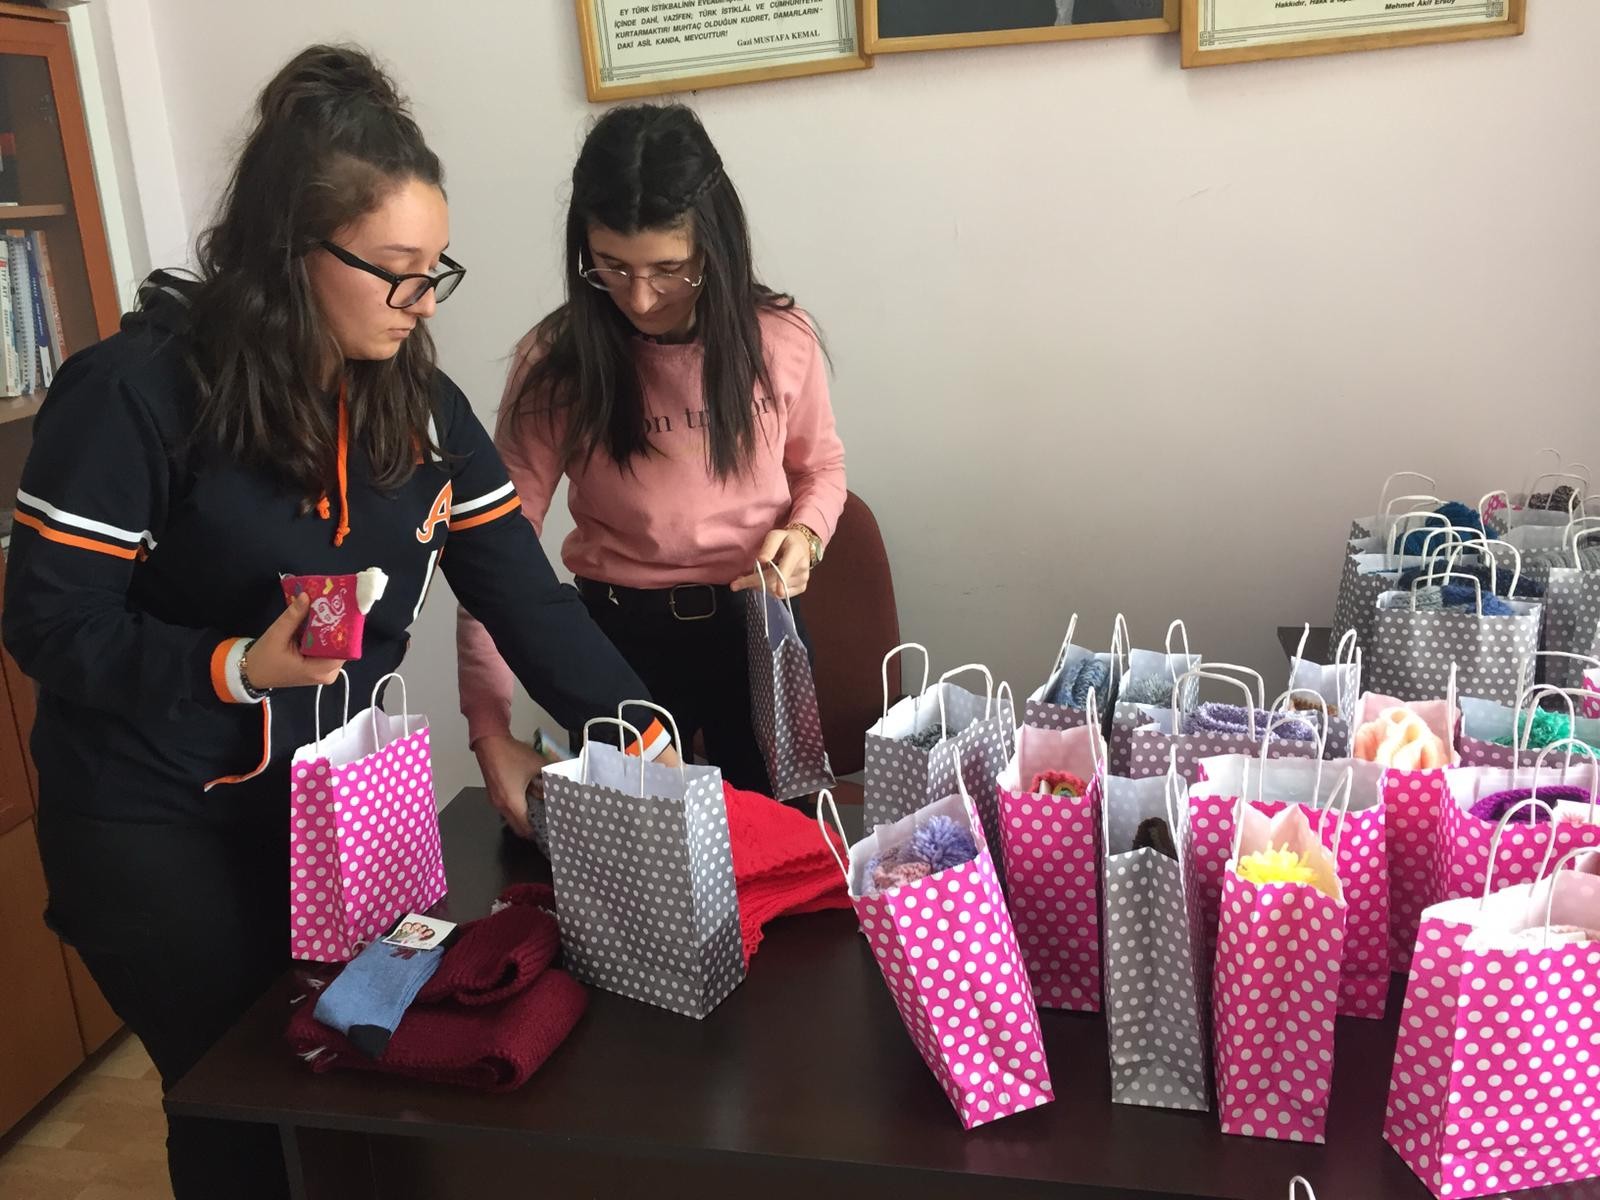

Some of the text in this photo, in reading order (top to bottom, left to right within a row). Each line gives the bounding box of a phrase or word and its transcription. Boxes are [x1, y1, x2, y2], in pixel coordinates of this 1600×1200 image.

[619, 8, 629, 16] EY
[631, 5, 650, 15] TÜRK
[1384, 1, 1415, 10] Mehmet
[614, 19, 637, 29] İÇİNDE
[698, 8, 718, 18] TÜRK
[755, 3, 766, 11] VE
[614, 25, 671, 39] KURTARMAKTIR!
[672, 21, 702, 32] MUHTAÇ
[703, 17, 738, 28] OLDUĞUN
[740, 13, 771, 24] KUDRET,
[616, 40, 635, 51] DAKİ
[655, 35, 681, 46] KANDA,
[683, 29, 729, 42] MEVCUTTUR!
[736, 29, 821, 47] Gazi MUSTAFA KEMAL
